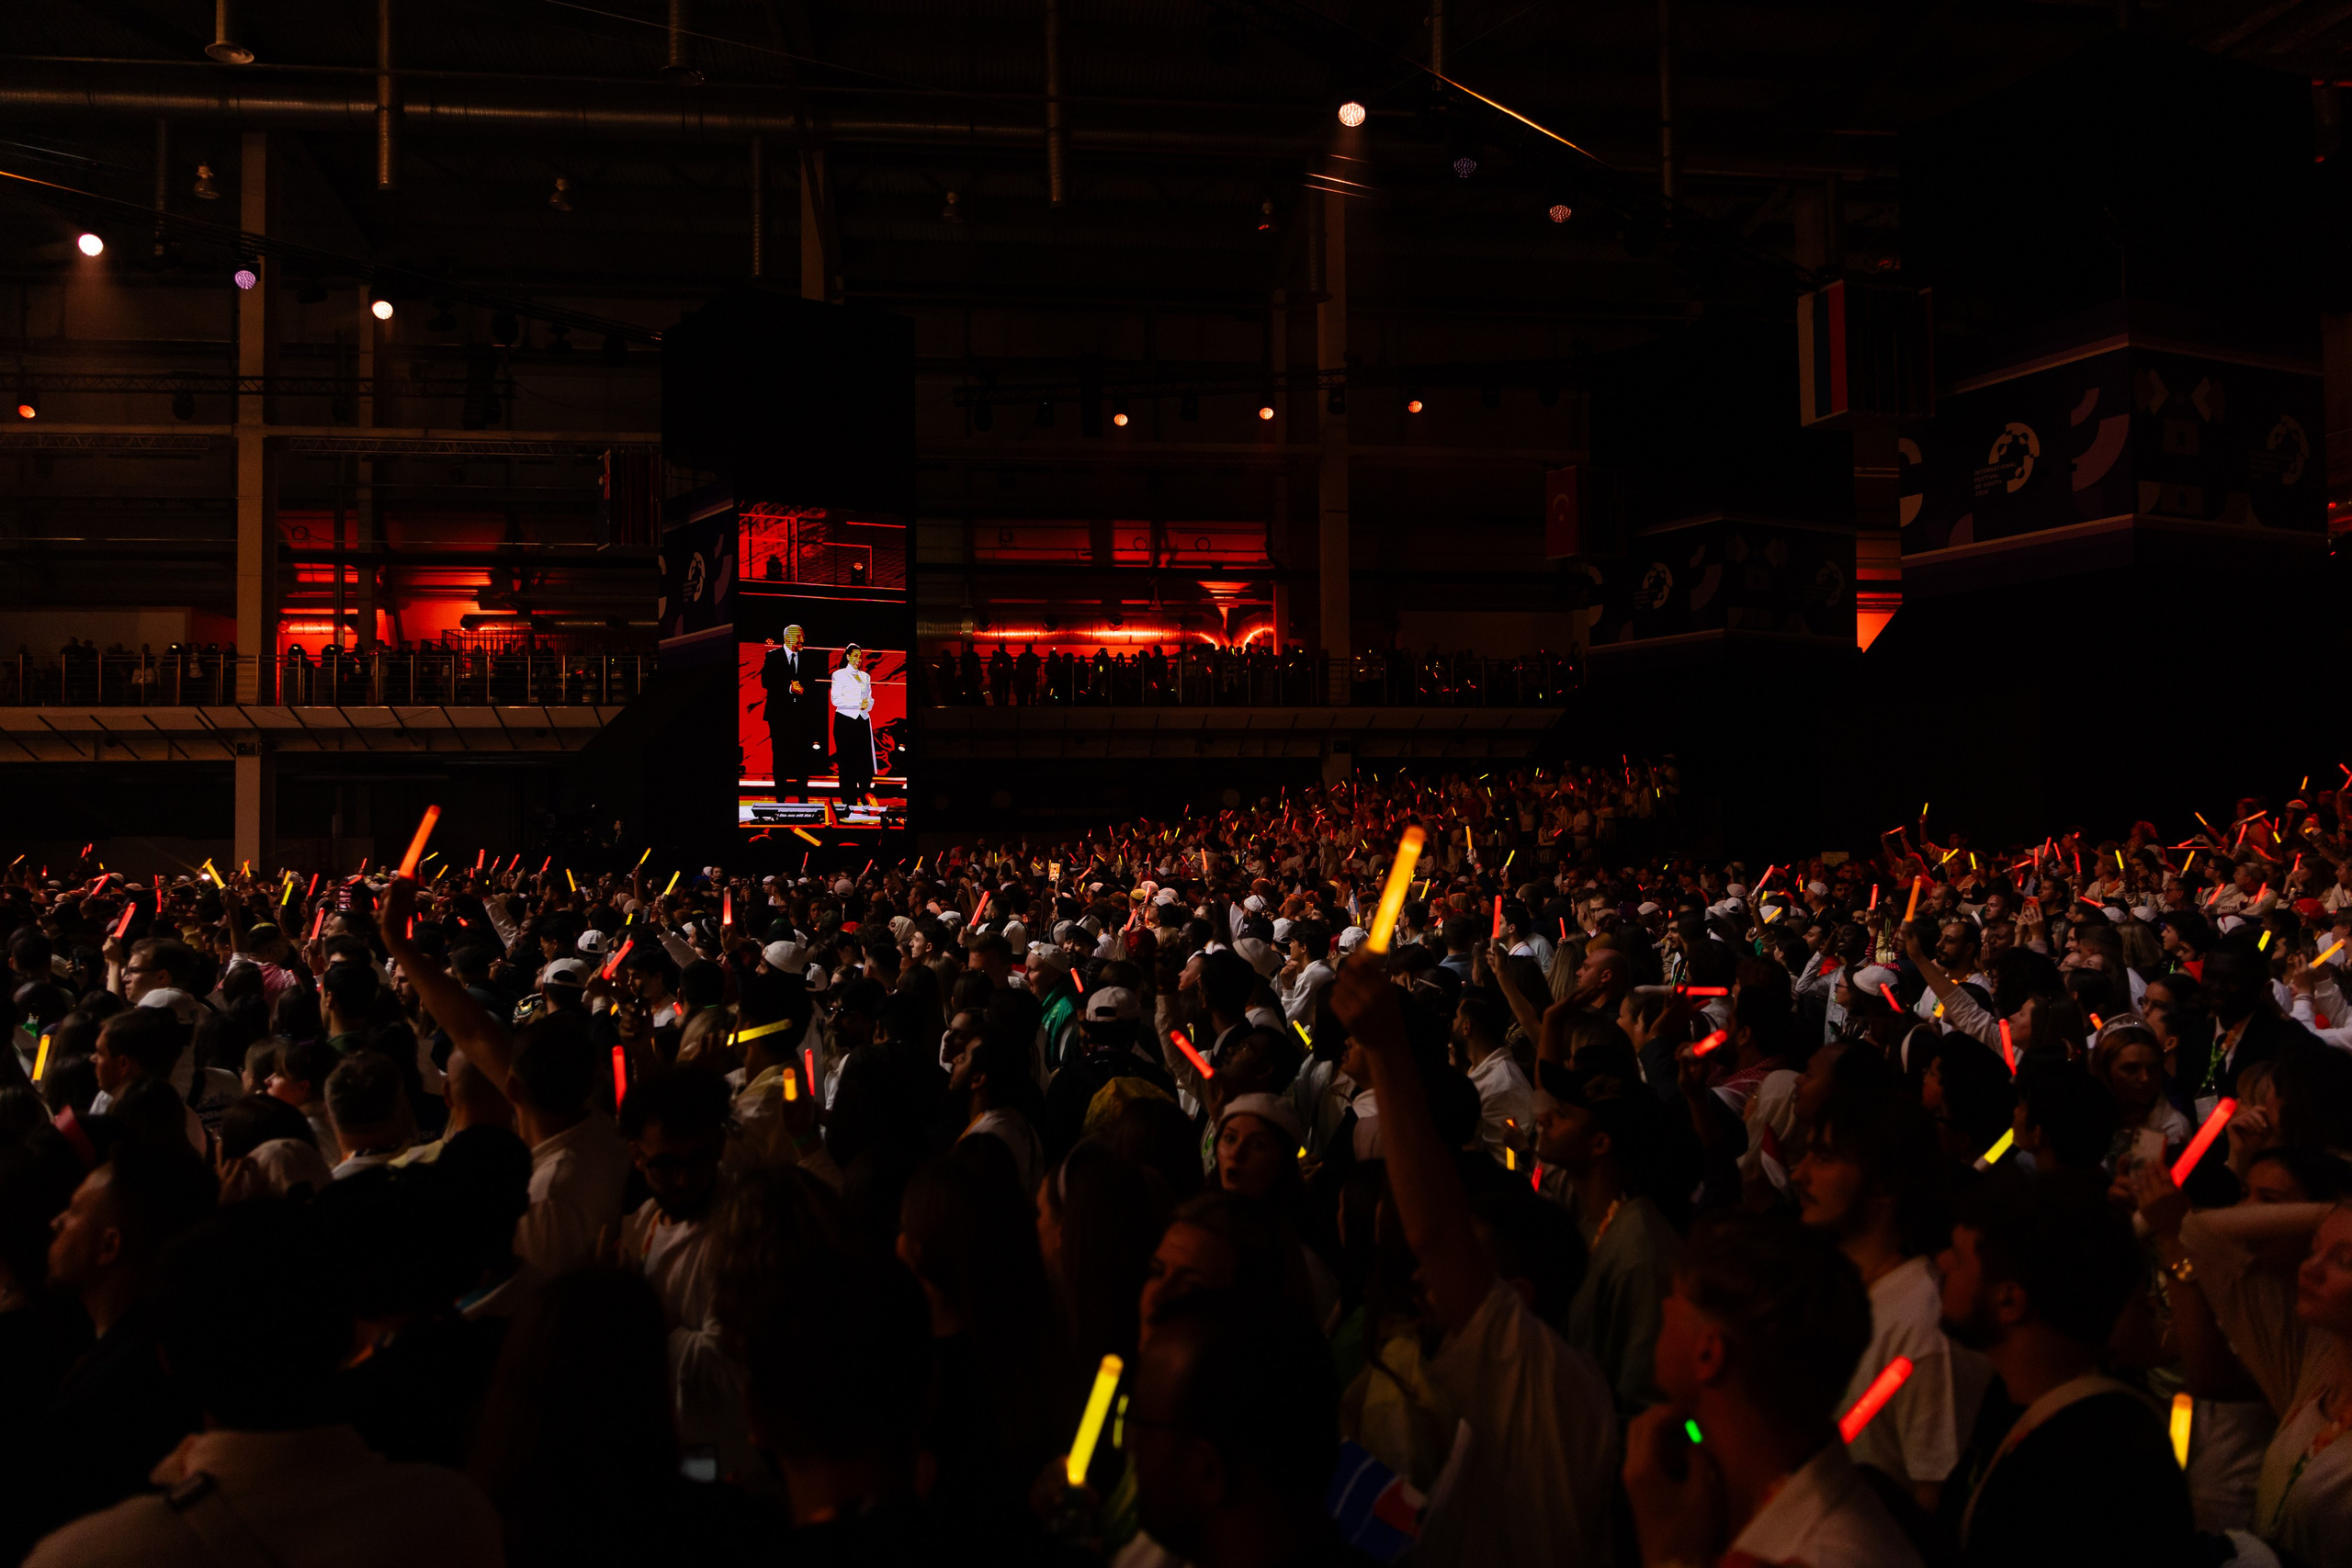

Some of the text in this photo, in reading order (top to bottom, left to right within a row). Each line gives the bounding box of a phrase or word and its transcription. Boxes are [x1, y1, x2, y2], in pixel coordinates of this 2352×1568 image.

[1973, 462, 2017, 475] INTERNATIONAL
[1974, 473, 1999, 482] FESTIVAL
[1983, 479, 2002, 488] YOUTH
